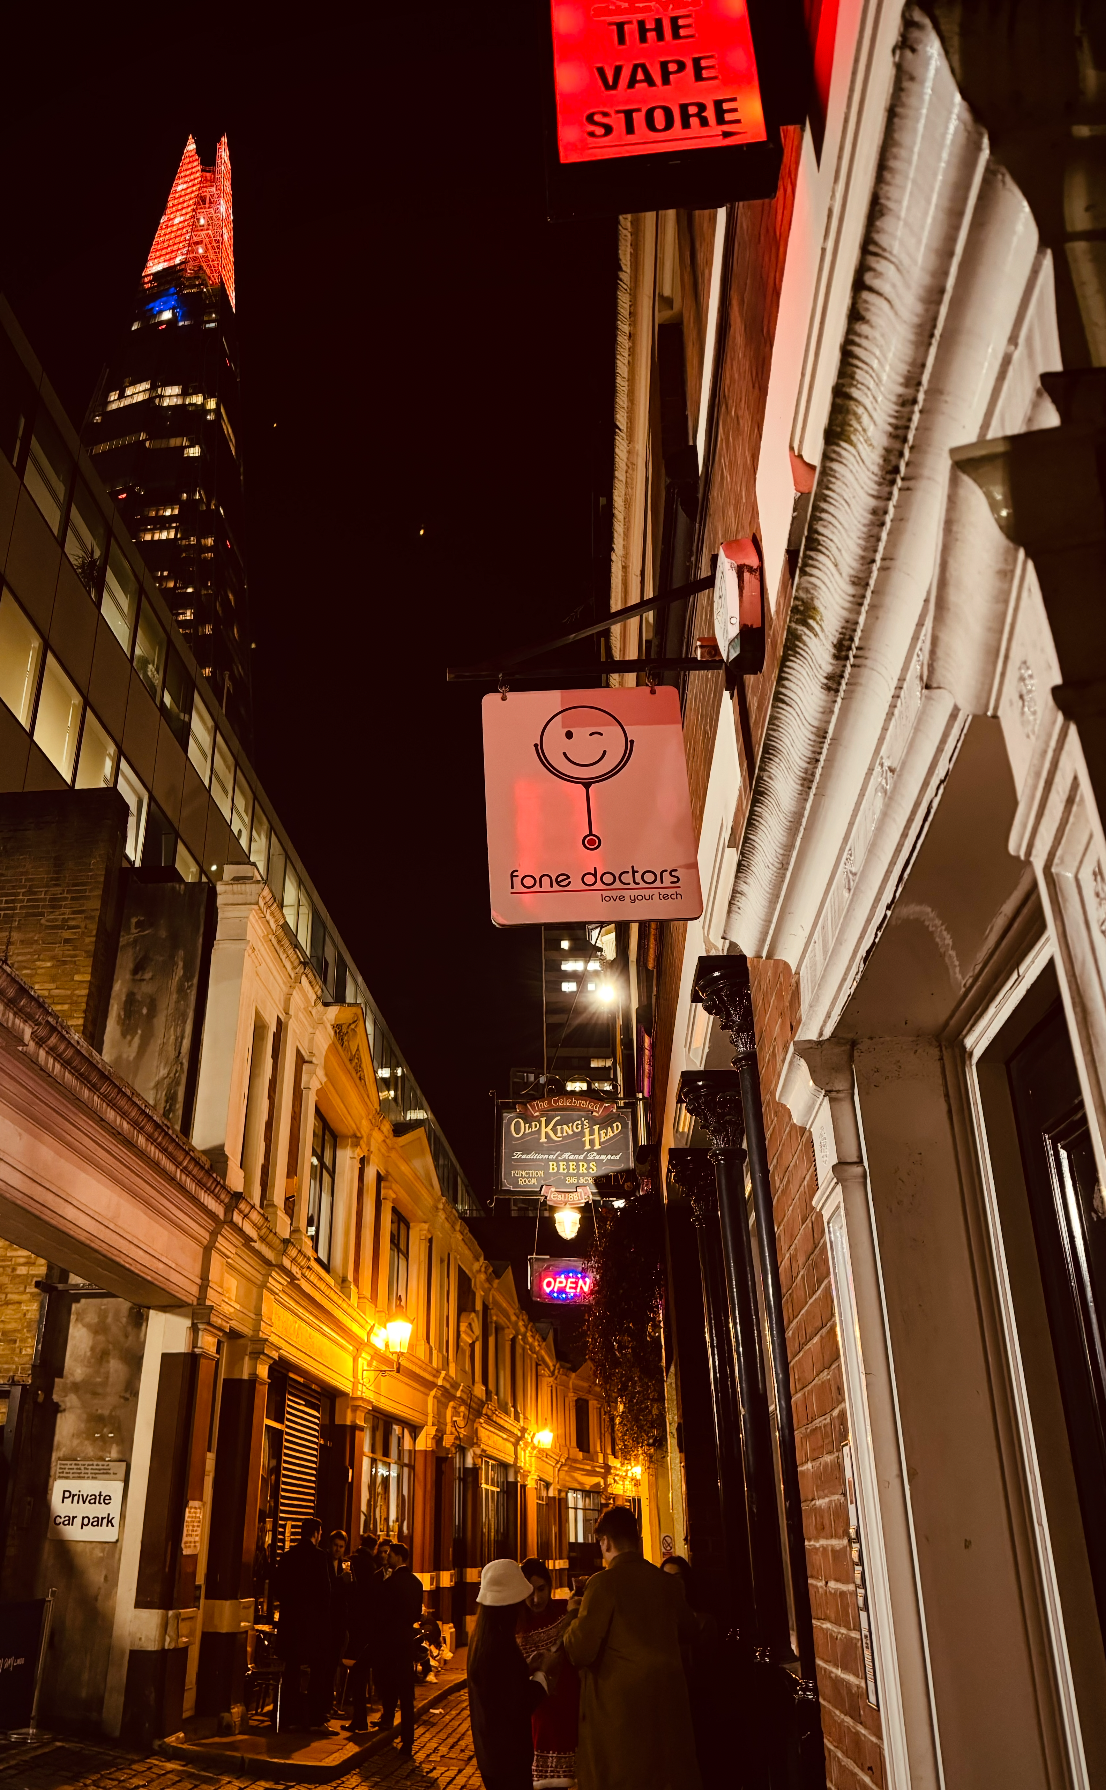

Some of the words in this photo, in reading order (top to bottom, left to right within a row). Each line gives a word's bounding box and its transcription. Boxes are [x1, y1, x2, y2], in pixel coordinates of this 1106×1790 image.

[607, 13, 696, 46] THE
[595, 54, 720, 91] VAPE
[584, 97, 742, 138] STORE
[510, 869, 571, 890] fone
[581, 865, 681, 887] doctors
[600, 893, 626, 903] love
[629, 893, 655, 904] your
[658, 891, 683, 901] tech
[532, 1100, 549, 1111] The
[551, 1096, 601, 1111] Celebrated
[511, 1118, 539, 1138] OLD
[582, 1121, 622, 1150] HEAD
[511, 1151, 561, 1160] Traditional
[558, 1152, 587, 1160] Hand
[586, 1152, 623, 1163] Pumped
[511, 1170, 545, 1178] FUNCTION
[548, 1161, 598, 1174] BEERS
[518, 1178, 538, 1186] ROOM
[565, 1176, 578, 1185] BIG
[543, 1277, 590, 1293] OPEN
[61, 1490, 112, 1505] Private
[53, 1514, 78, 1526] car
[80, 1513, 115, 1530] park
